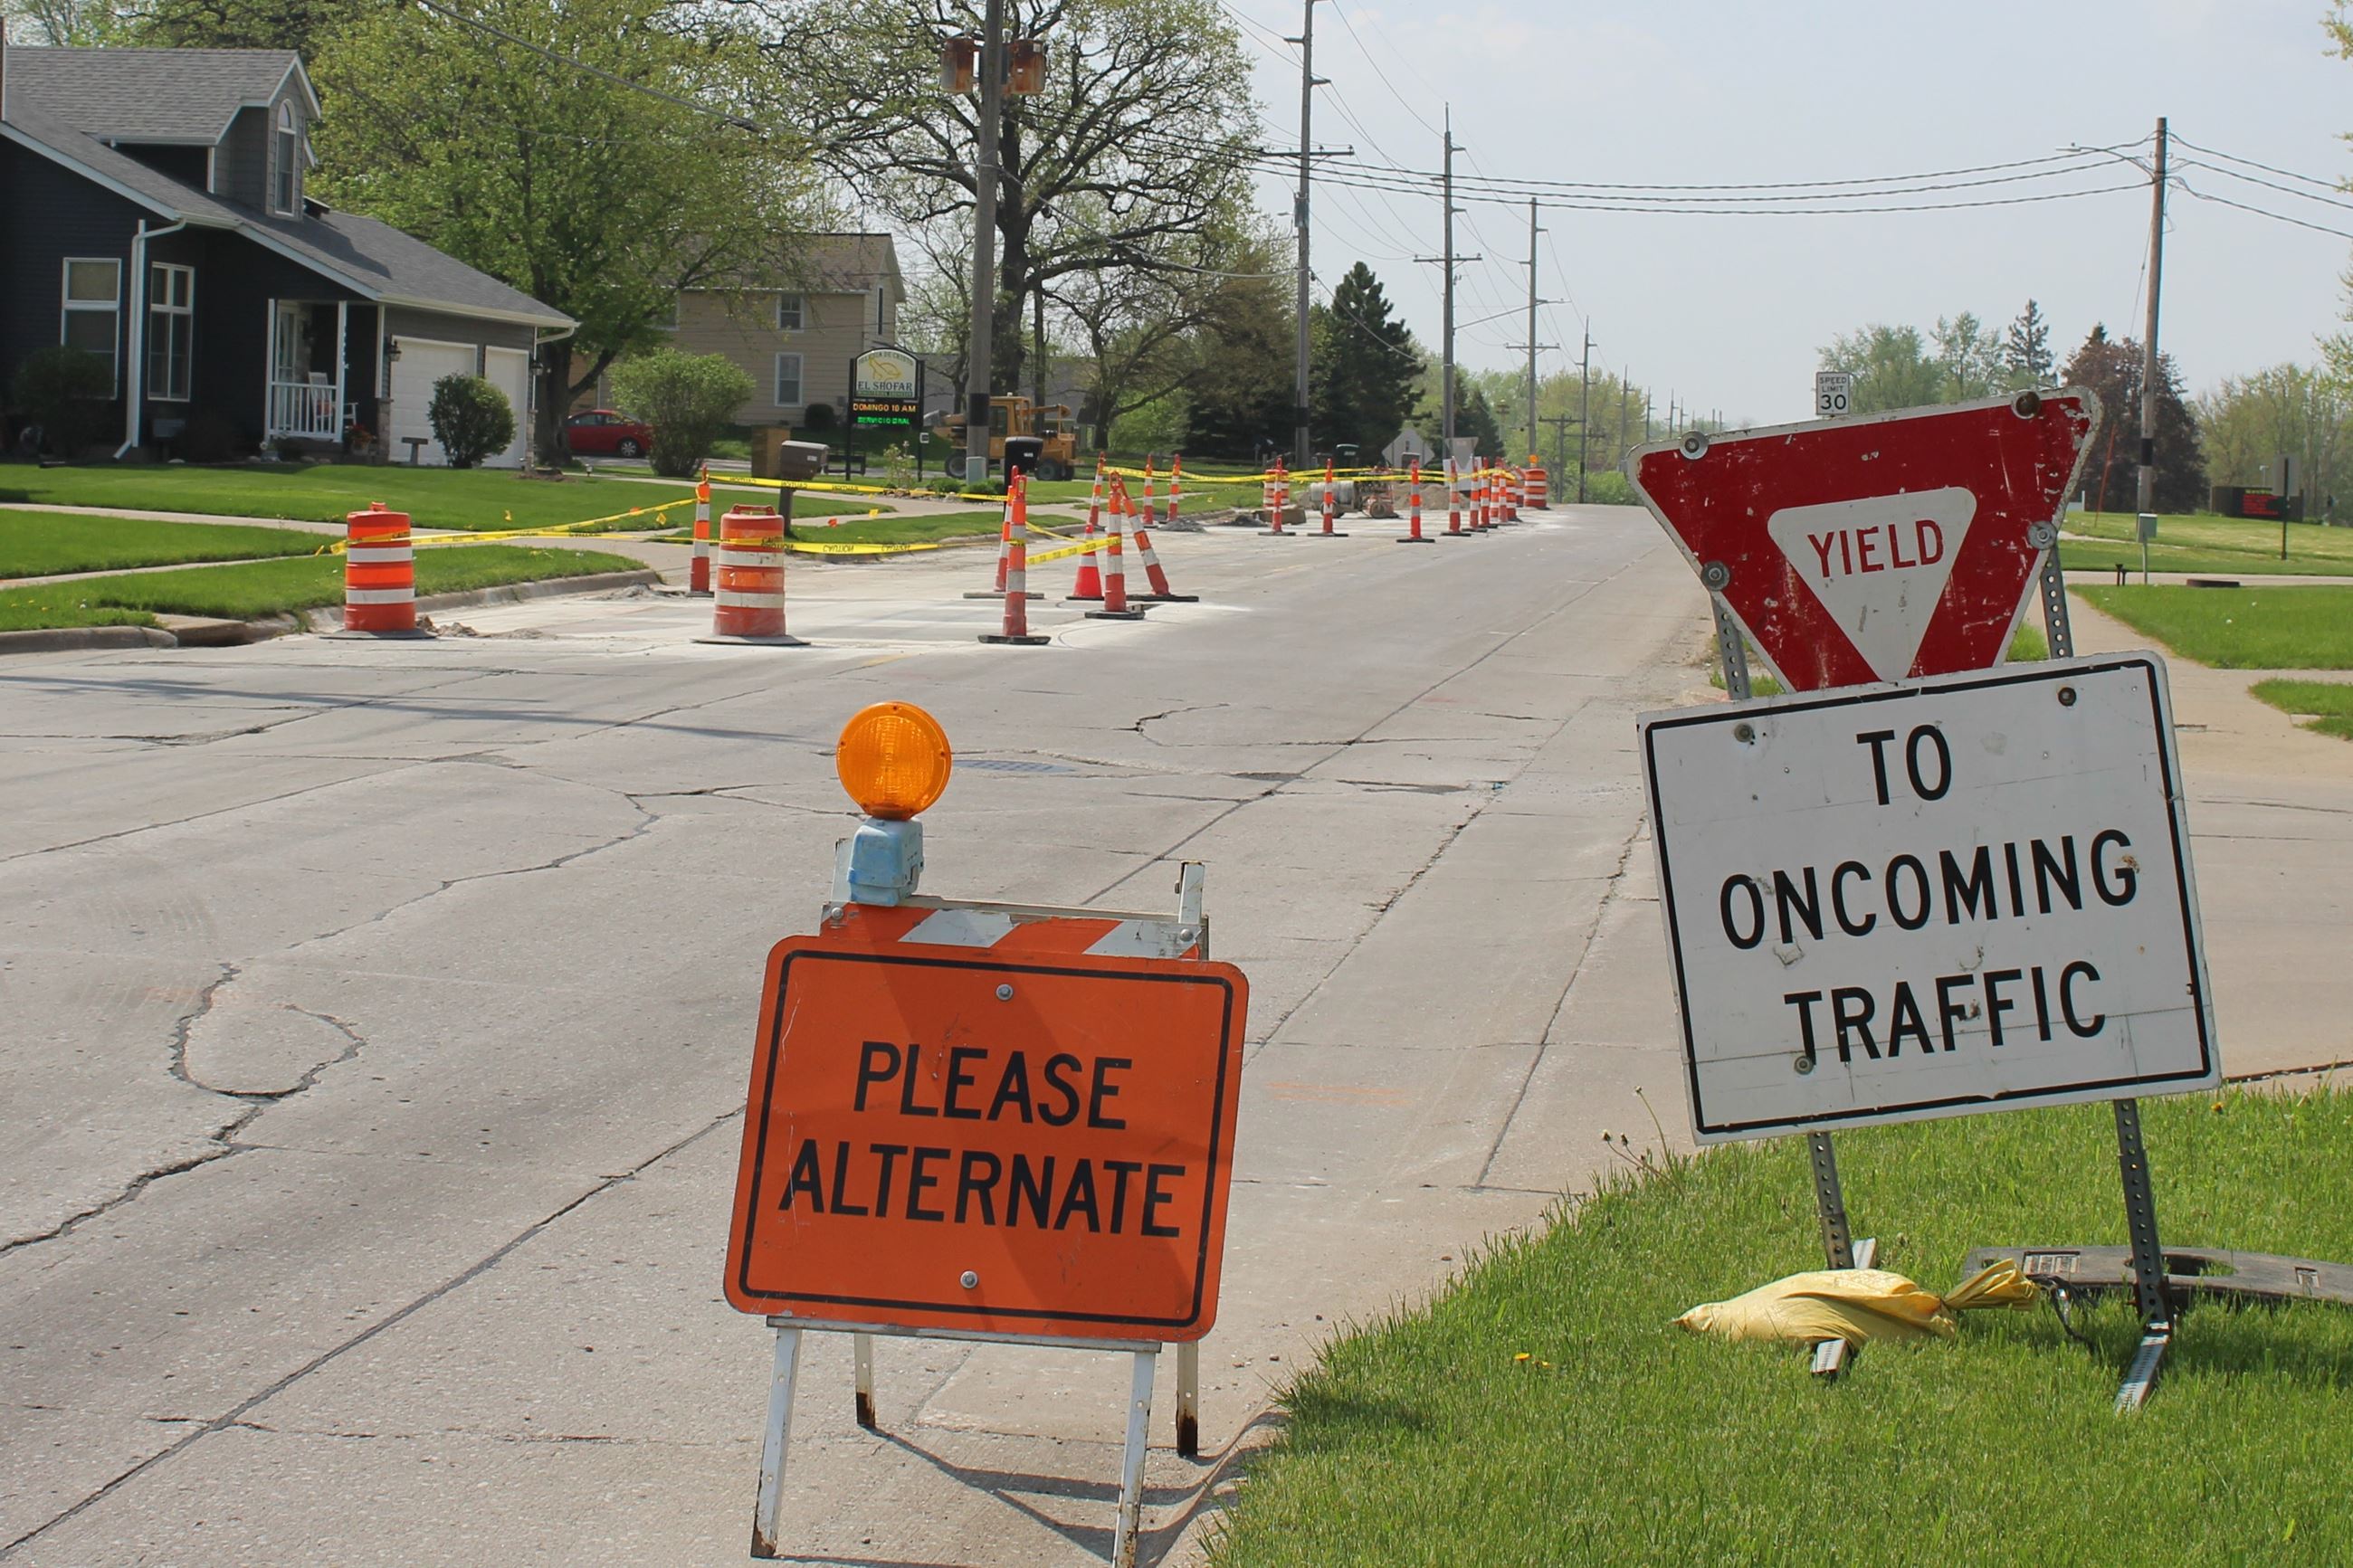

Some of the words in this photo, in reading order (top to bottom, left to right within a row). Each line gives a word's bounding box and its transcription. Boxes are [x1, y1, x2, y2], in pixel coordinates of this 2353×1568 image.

[853, 404, 890, 412] DOMINGO
[901, 404, 916, 413] AM
[858, 381, 871, 390] EL
[873, 381, 912, 391] SHOFAR
[1821, 394, 1846, 410] 30
[1807, 518, 1946, 579] YIELD
[1856, 724, 1952, 806] TO
[1720, 829, 2139, 950] ONCOMING
[1784, 961, 2106, 1067] TRAFFIC
[853, 1041, 1133, 1130] PLEASE
[778, 1139, 1186, 1238] ALTERNATE
